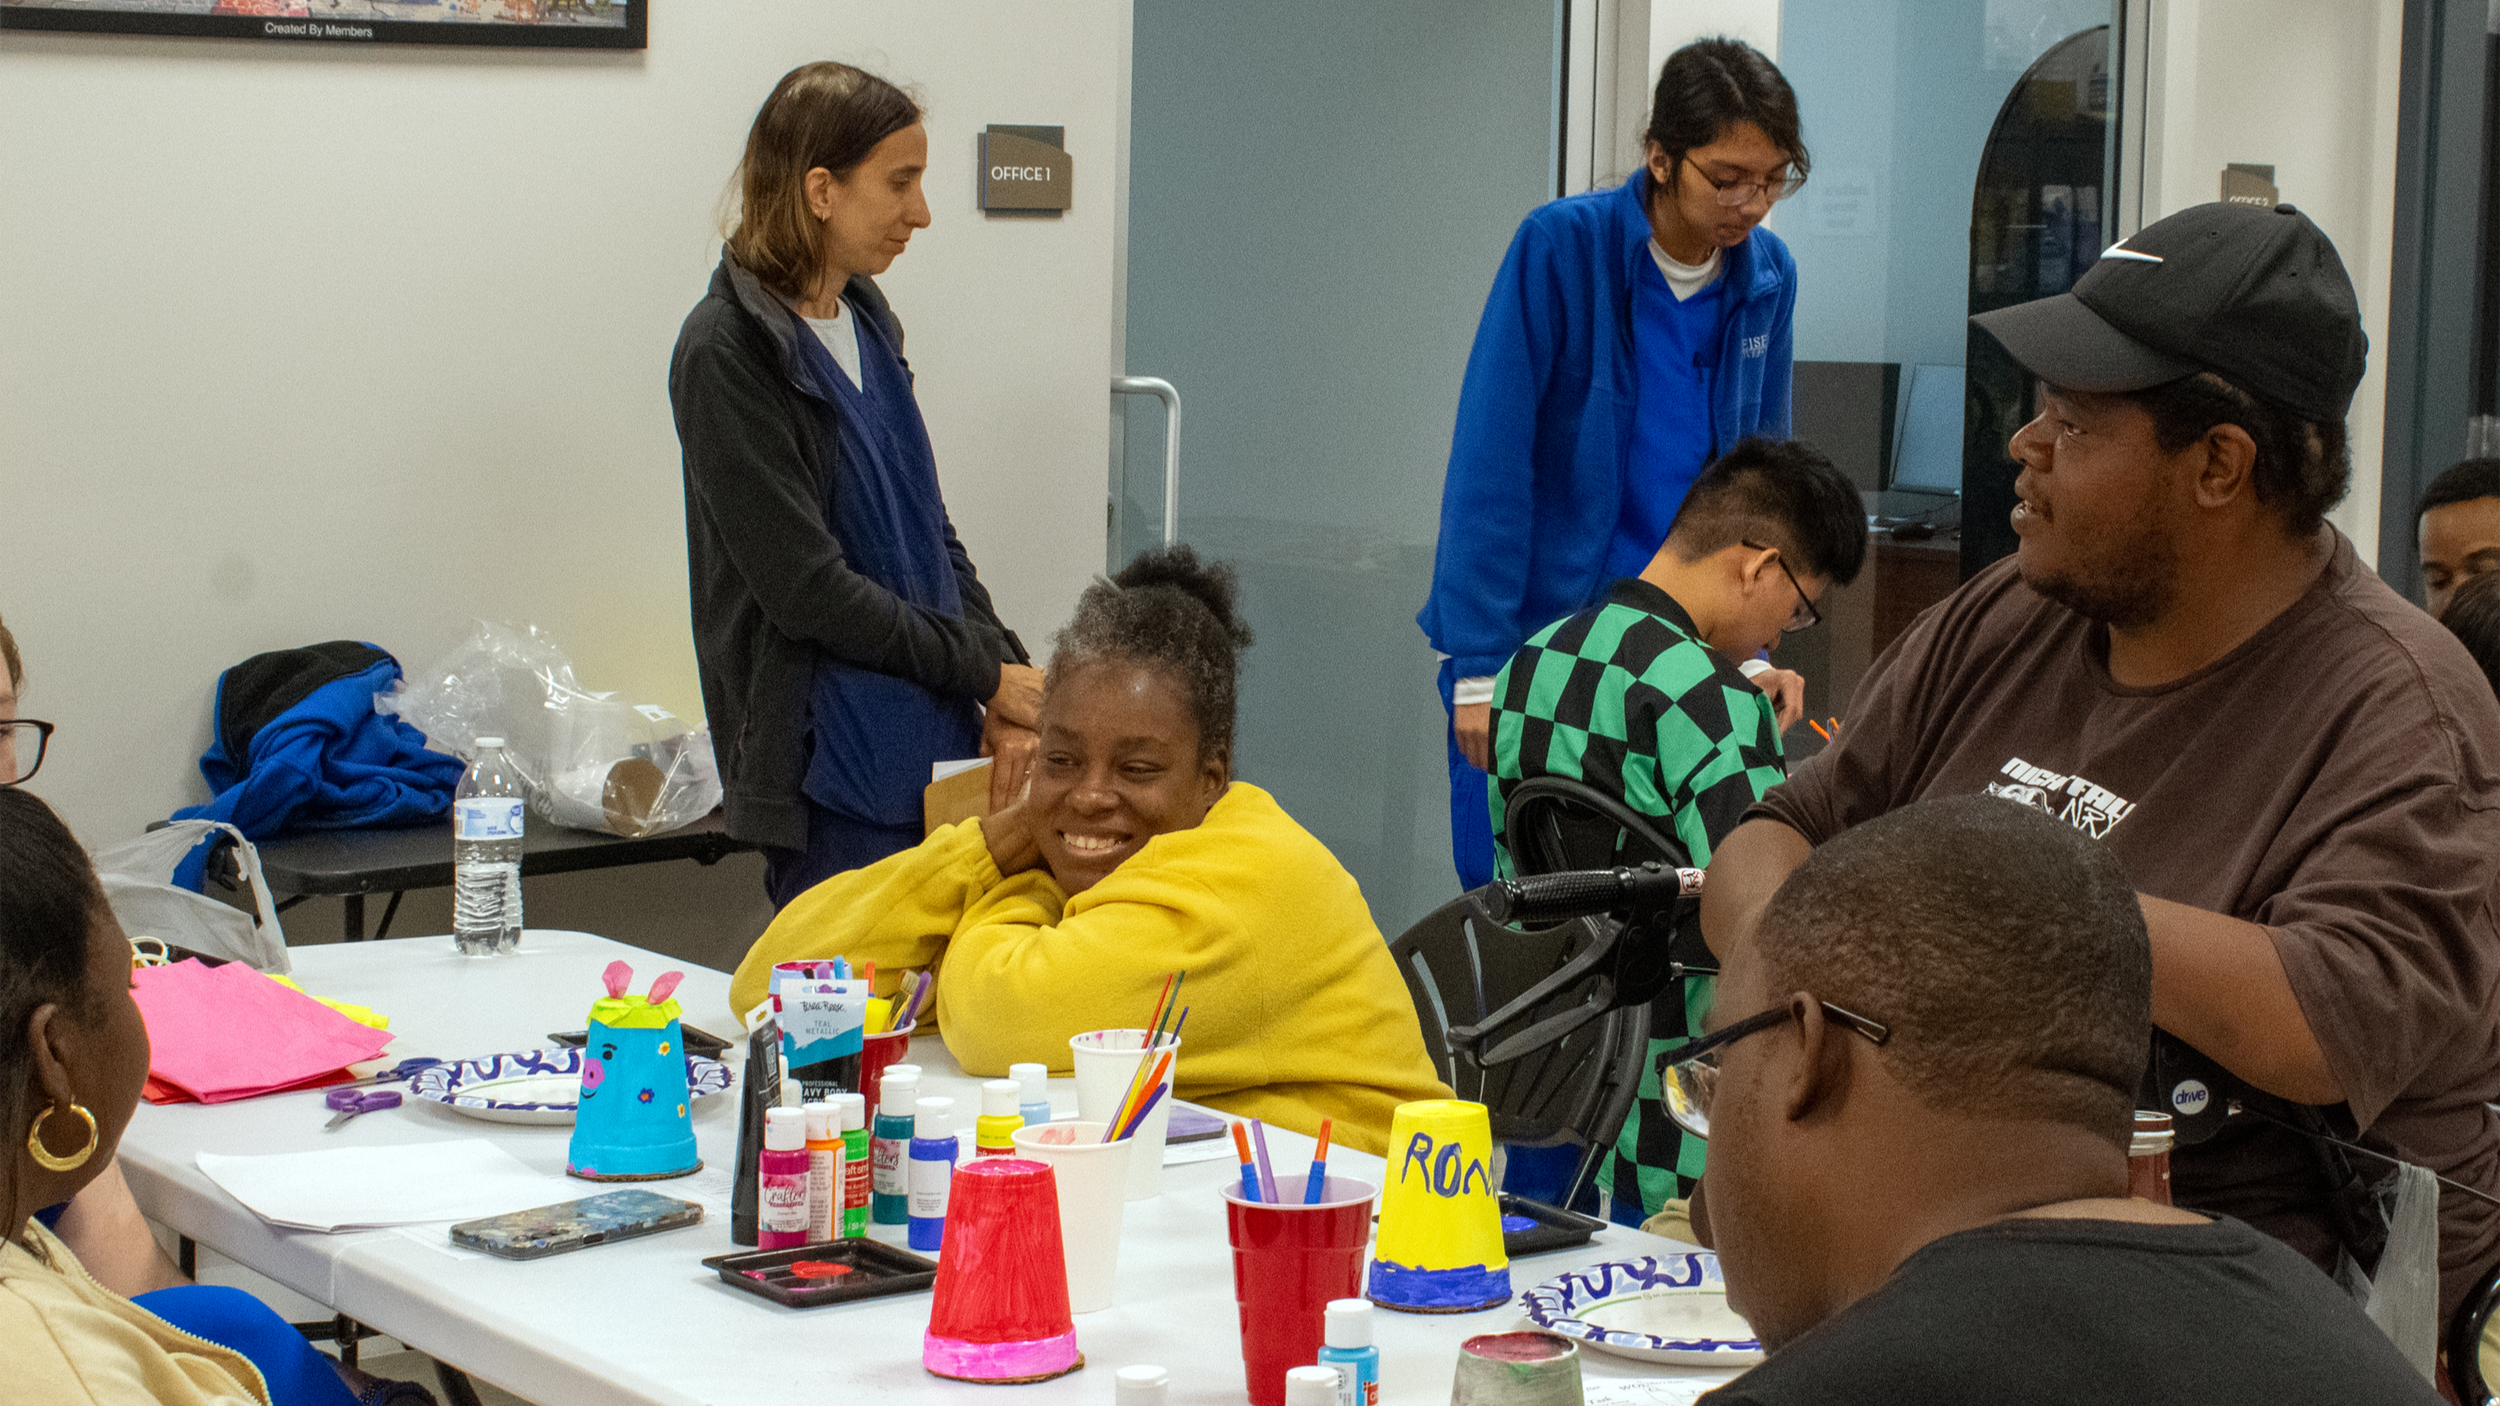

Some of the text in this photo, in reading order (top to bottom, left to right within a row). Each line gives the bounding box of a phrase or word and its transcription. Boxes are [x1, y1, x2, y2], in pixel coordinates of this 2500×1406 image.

[265, 22, 373, 37] Created By Members
[991, 166, 1051, 181] OFFICE 1
[814, 1020, 831, 1028] TEAL
[805, 1027, 840, 1036] METALLIC
[803, 1088, 822, 1097] AVY
[2175, 1089, 2207, 1105] drive
